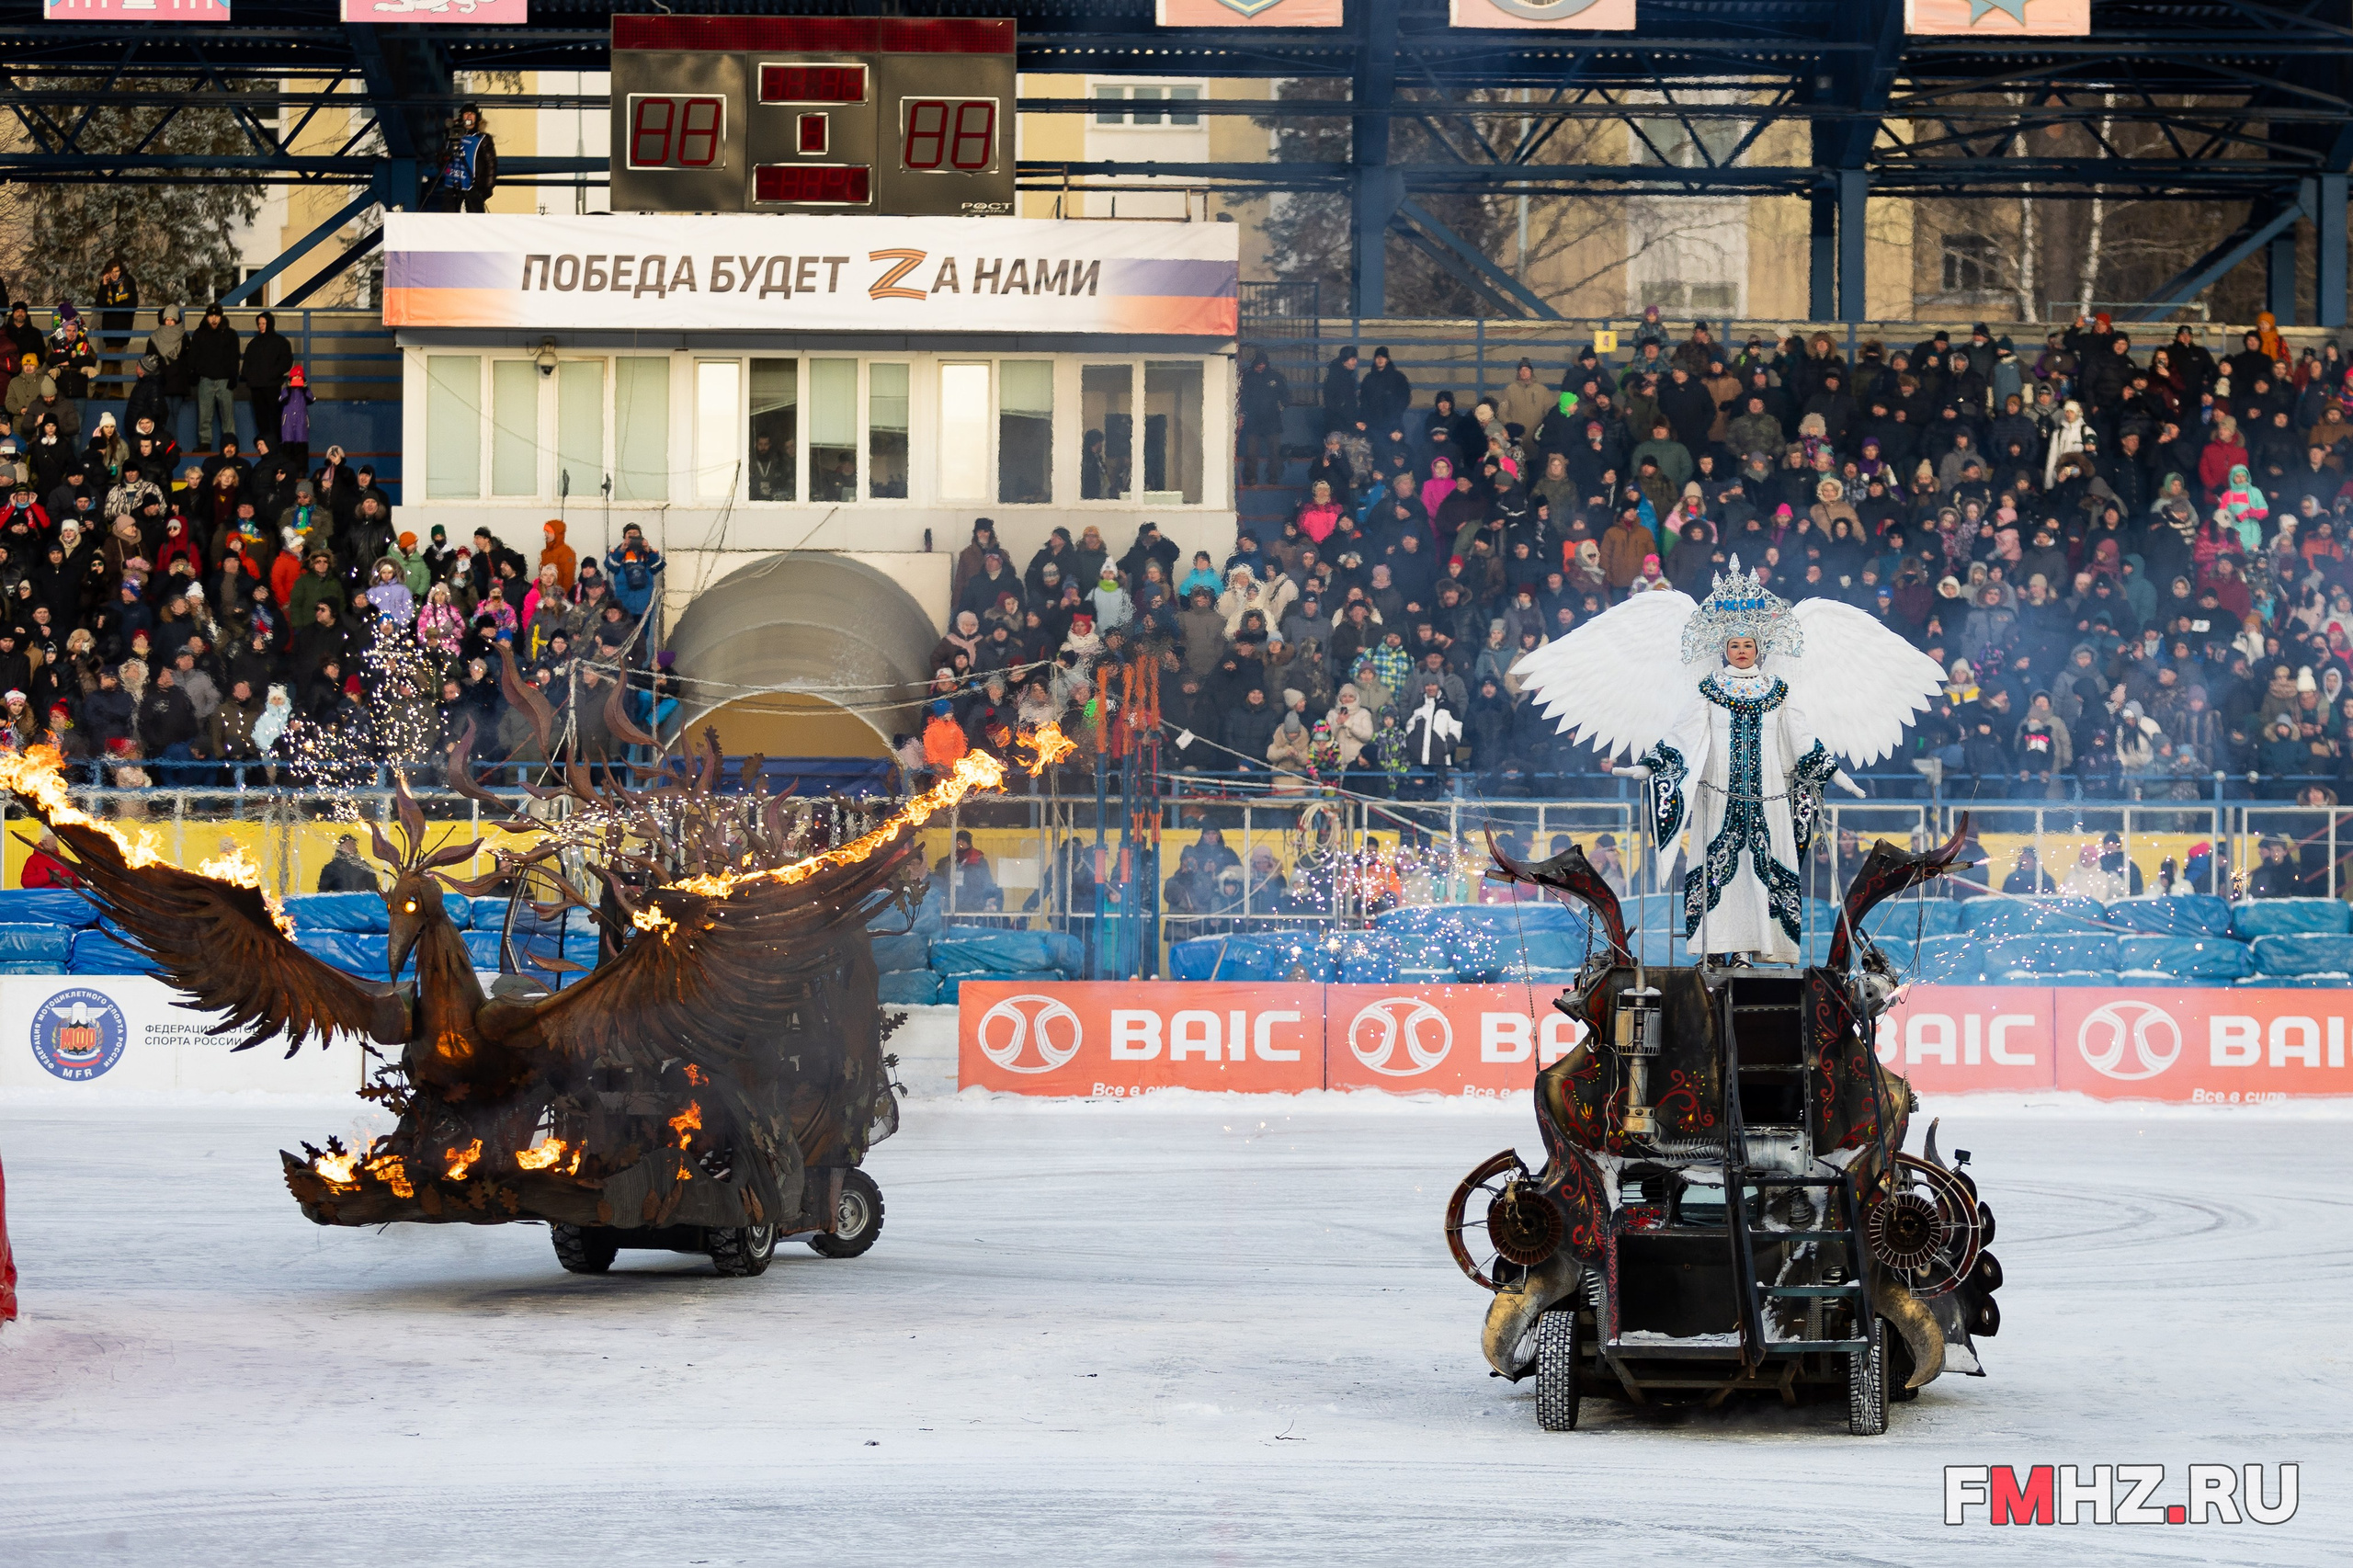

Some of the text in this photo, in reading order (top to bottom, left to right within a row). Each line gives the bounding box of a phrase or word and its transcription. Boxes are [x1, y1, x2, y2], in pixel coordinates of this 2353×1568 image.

[521, 254, 698, 300] ПОБЕДА
[710, 256, 850, 300] БУДЕТ
[972, 257, 1101, 297] НАМИ
[1715, 597, 1766, 612] РОССИЯ
[33, 990, 124, 1070] ФЕДЕРАЦИЯ МОТОЦИКЛЕТНОГО СПОРТА РОССИИ
[60, 1026, 97, 1051] МФР
[1109, 1009, 1301, 1062] BAIC
[1481, 1012, 1590, 1063] BA
[145, 1037, 242, 1046] СПОРТА РОССИИ
[2209, 1015, 2353, 1068] BAI
[62, 1067, 93, 1079] MFR
[1092, 1082, 1125, 1097] Все
[1129, 1085, 1141, 1097] в
[1463, 1085, 1496, 1098] Все
[2191, 1087, 2225, 1103] Все
[2229, 1091, 2241, 1103] в
